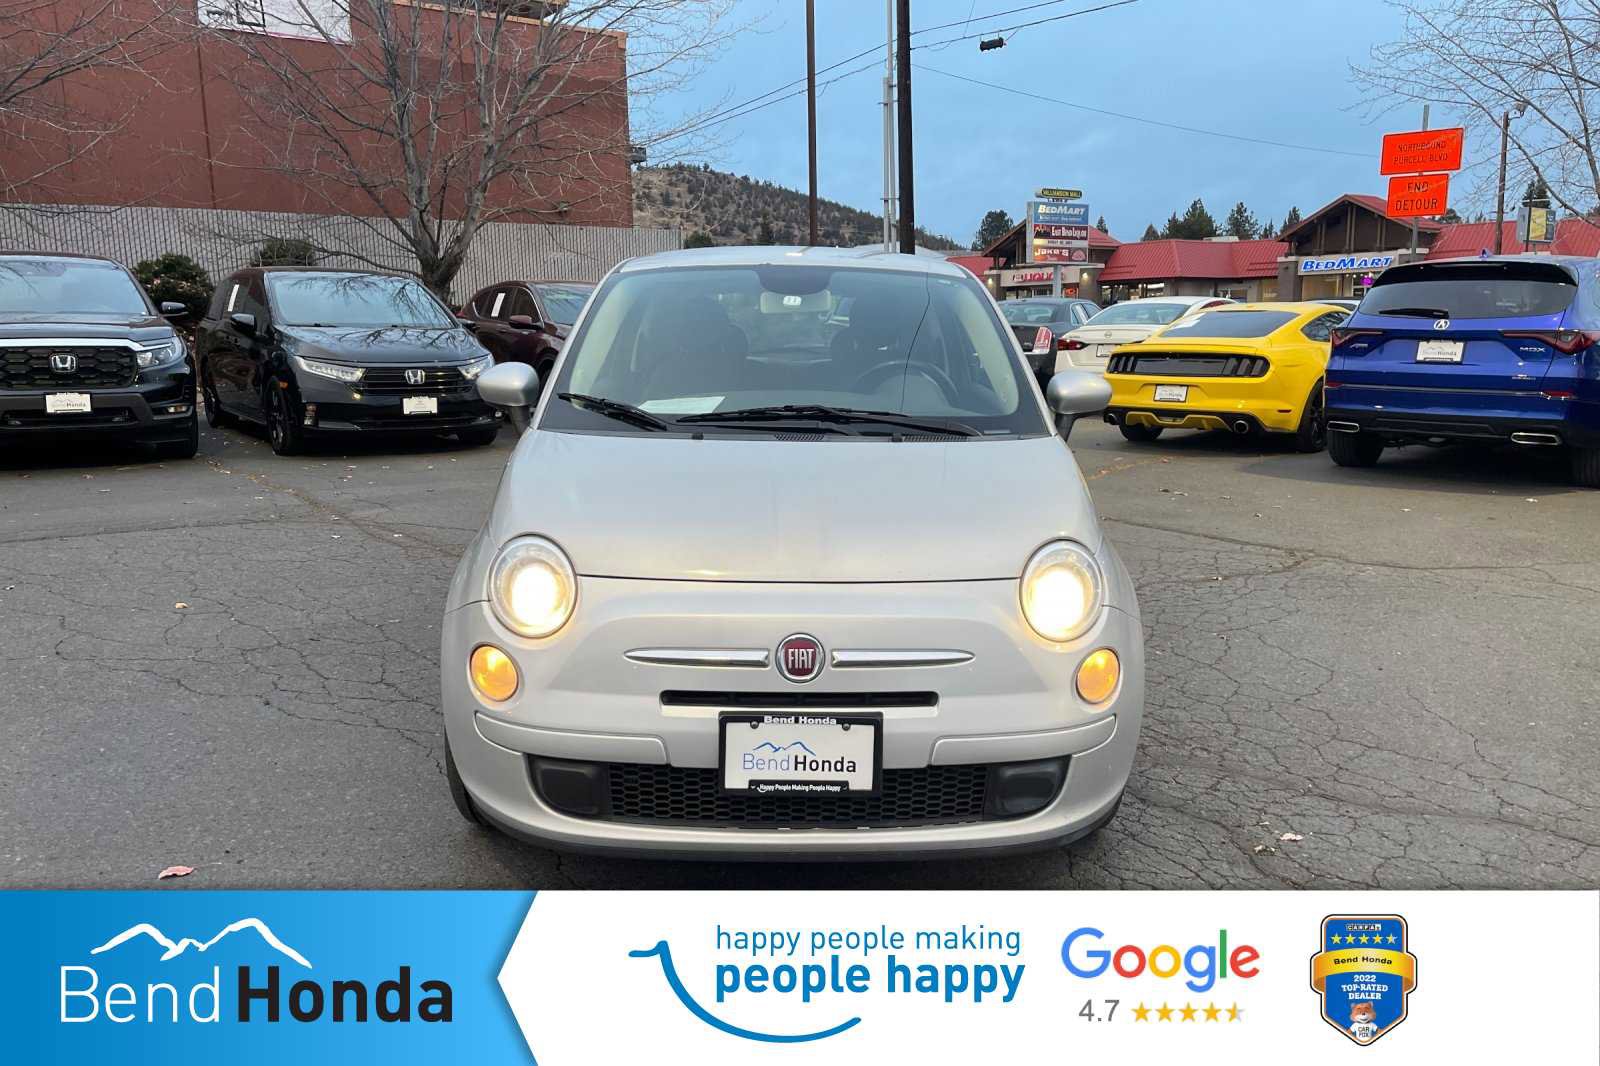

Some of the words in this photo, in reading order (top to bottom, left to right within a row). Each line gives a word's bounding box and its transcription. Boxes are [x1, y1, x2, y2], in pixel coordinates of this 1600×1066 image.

[1407, 181, 1429, 193] END
[1395, 198, 1438, 211] DETOUR
[788, 648, 815, 669] FIAT
[764, 715, 795, 724] Bend
[799, 716, 837, 726] Honda
[742, 753, 790, 771] Bend
[794, 754, 857, 773] Honda
[775, 784, 791, 792] People
[792, 784, 809, 792] Making
[810, 784, 825, 792] People
[826, 784, 841, 792] Happy
